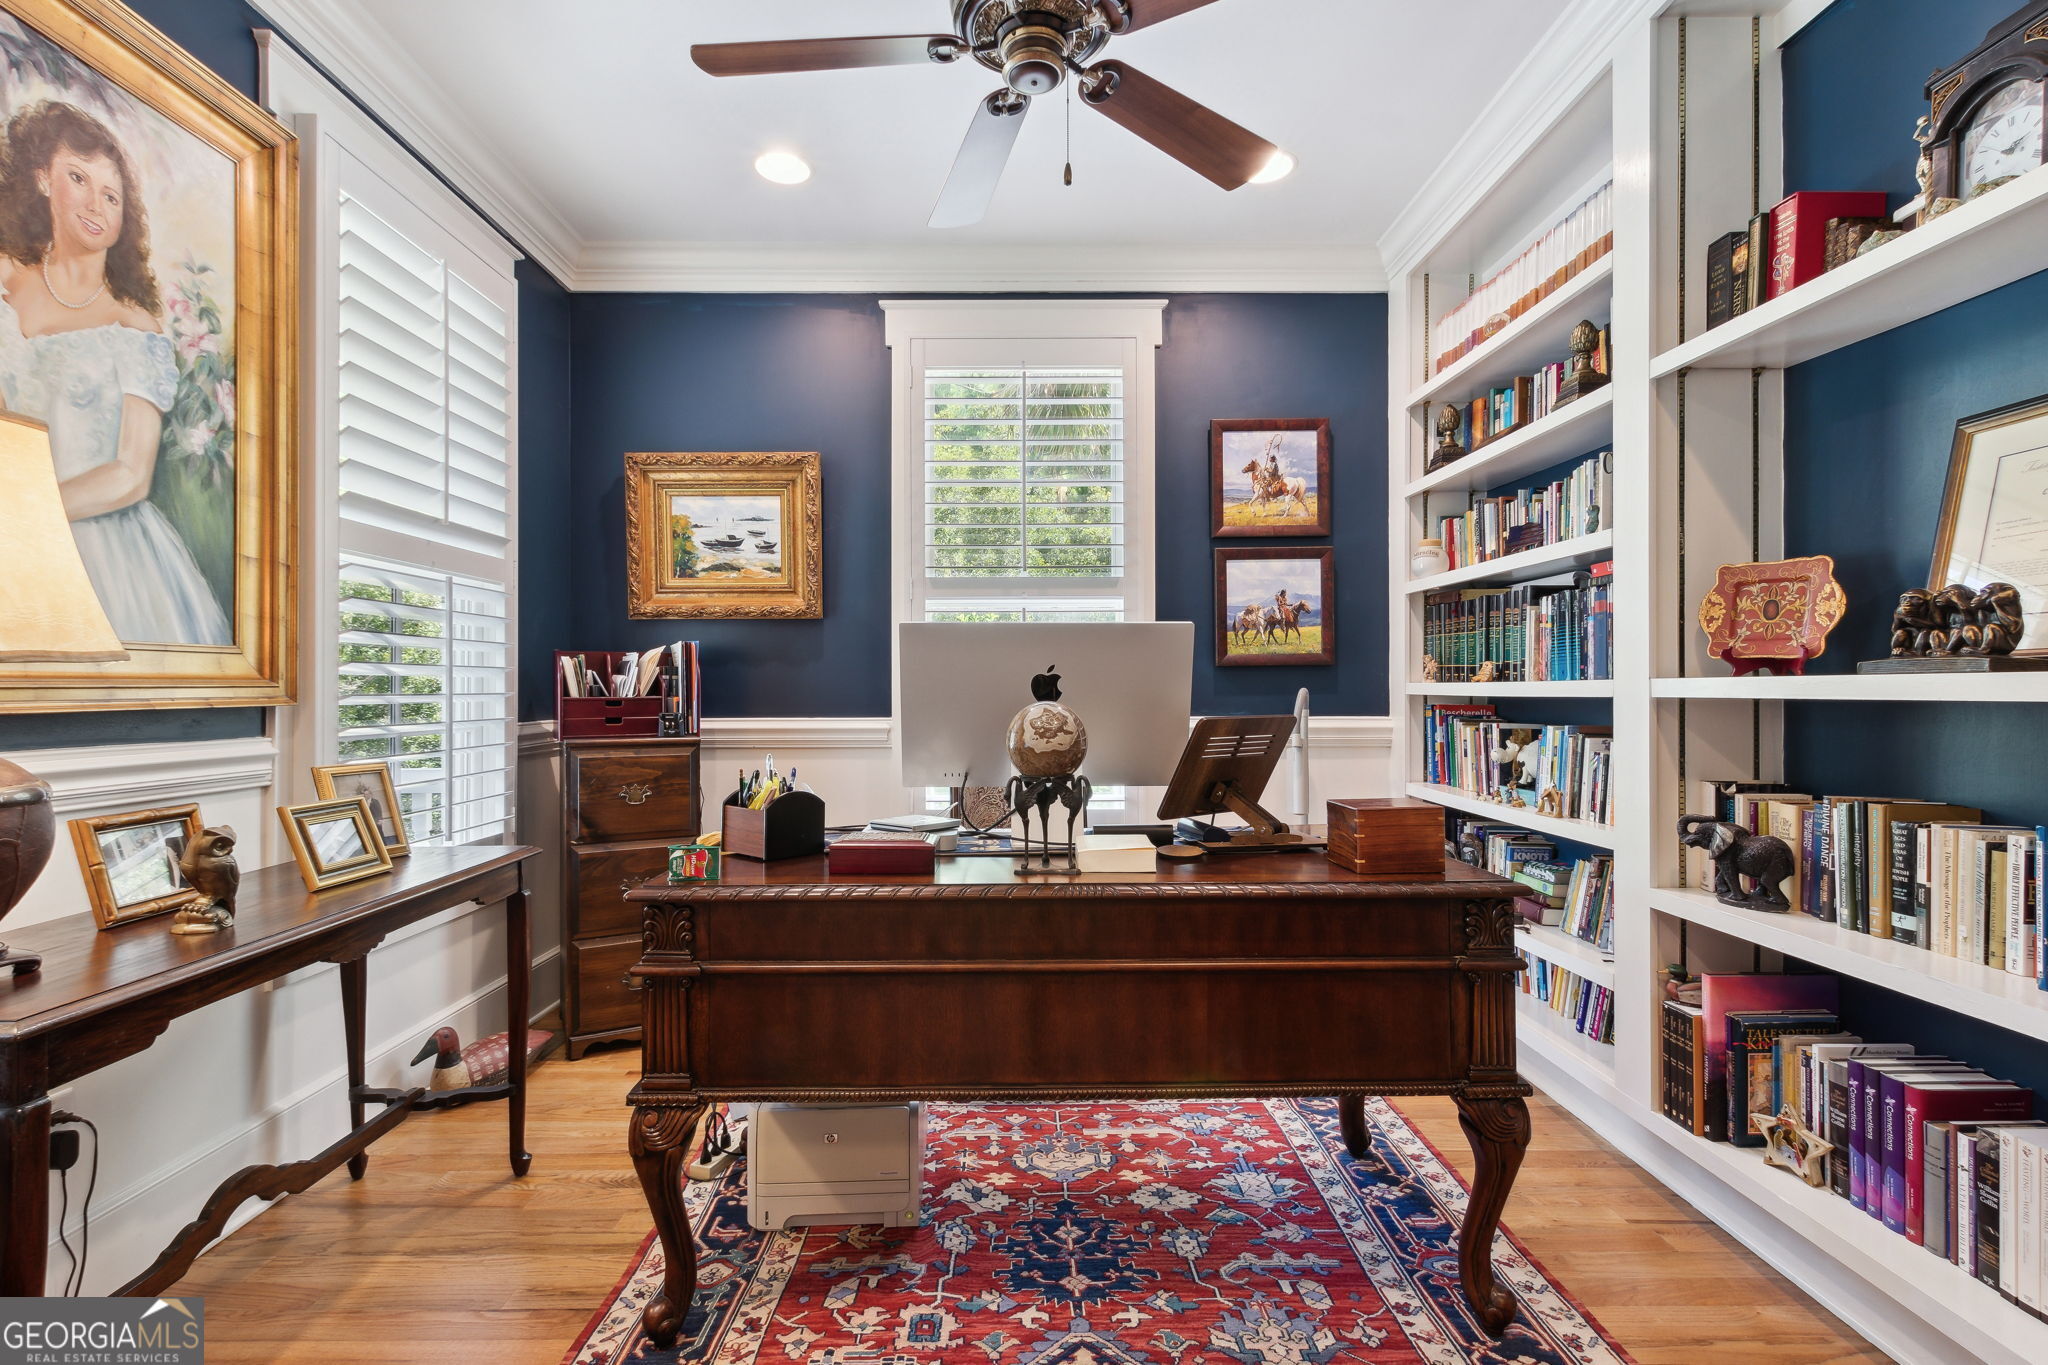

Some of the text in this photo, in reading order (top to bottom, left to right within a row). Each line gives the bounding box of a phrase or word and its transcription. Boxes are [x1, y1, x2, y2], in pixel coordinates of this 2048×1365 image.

[1820, 804, 1831, 868] DIVINE DANCE
[1513, 852, 1550, 861] KNOTS
[1854, 833, 1862, 867] integrity
[1943, 865, 1951, 891] Message
[2012, 863, 2020, 884] HIGHLY
[1944, 900, 1952, 910] the
[2011, 885, 2020, 917] EFFECTIVE
[1943, 912, 1952, 939] Prophets
[2010, 918, 2019, 939] PEOPLE
[1746, 1028, 1786, 1037] TALES
[1849, 1087, 1857, 1131] Connections
[1866, 1095, 1874, 1140] Connections
[1886, 1105, 1894, 1151] Connections
[1977, 1181, 2000, 1197] William
[1979, 1189, 1998, 1203] Sloane
[1979, 1196, 1998, 1209] Coffin
